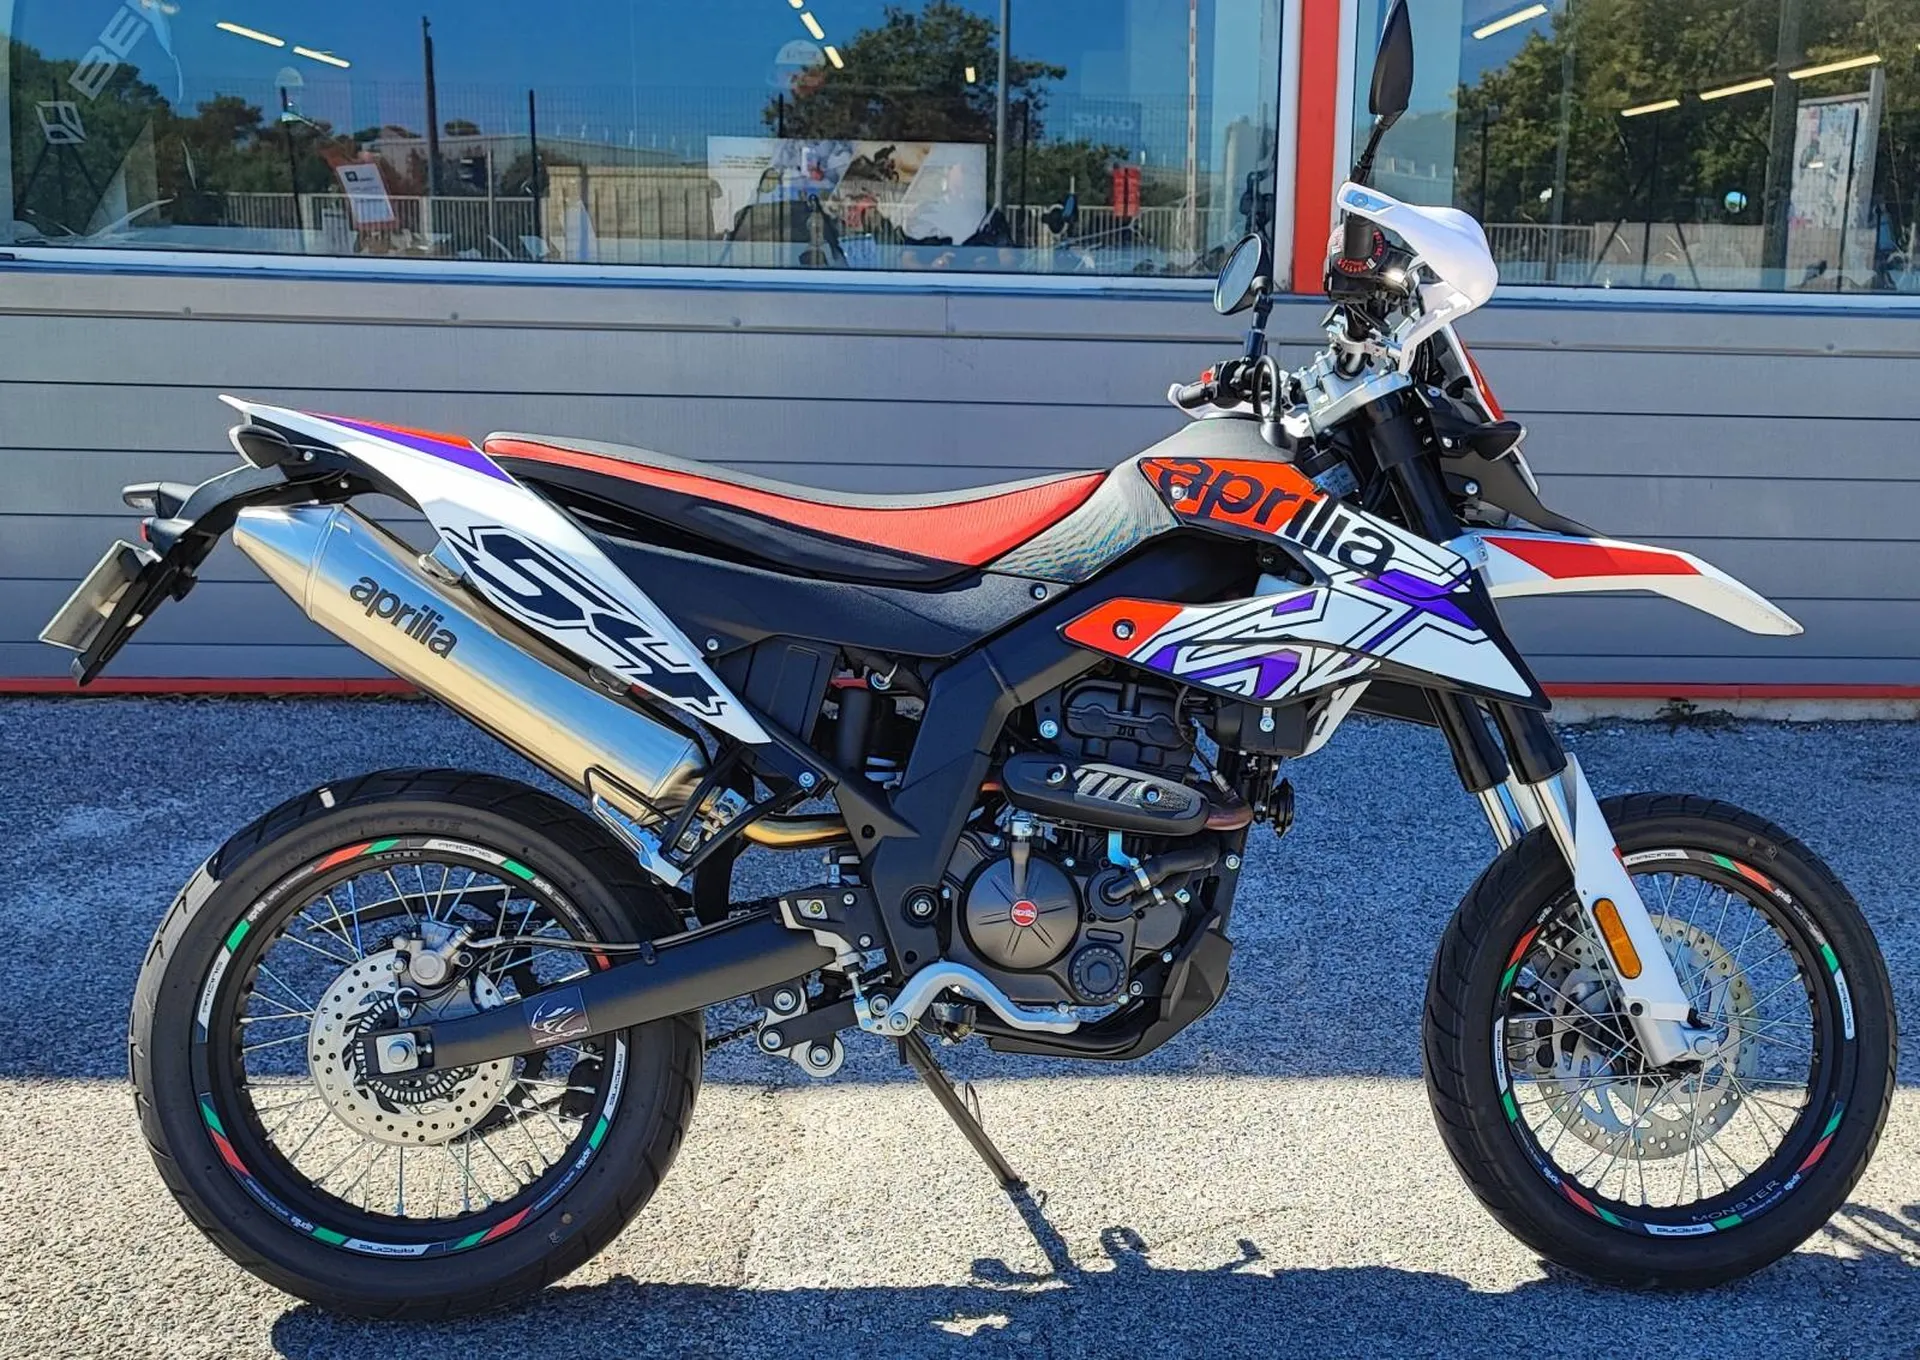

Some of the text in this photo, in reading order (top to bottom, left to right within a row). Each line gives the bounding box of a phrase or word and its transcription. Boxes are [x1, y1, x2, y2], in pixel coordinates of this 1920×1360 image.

[67, 0, 153, 101] BE
[1157, 458, 1395, 579] aprilia
[350, 576, 458, 659] aprilia
[1691, 1179, 1781, 1223] MONSTER
